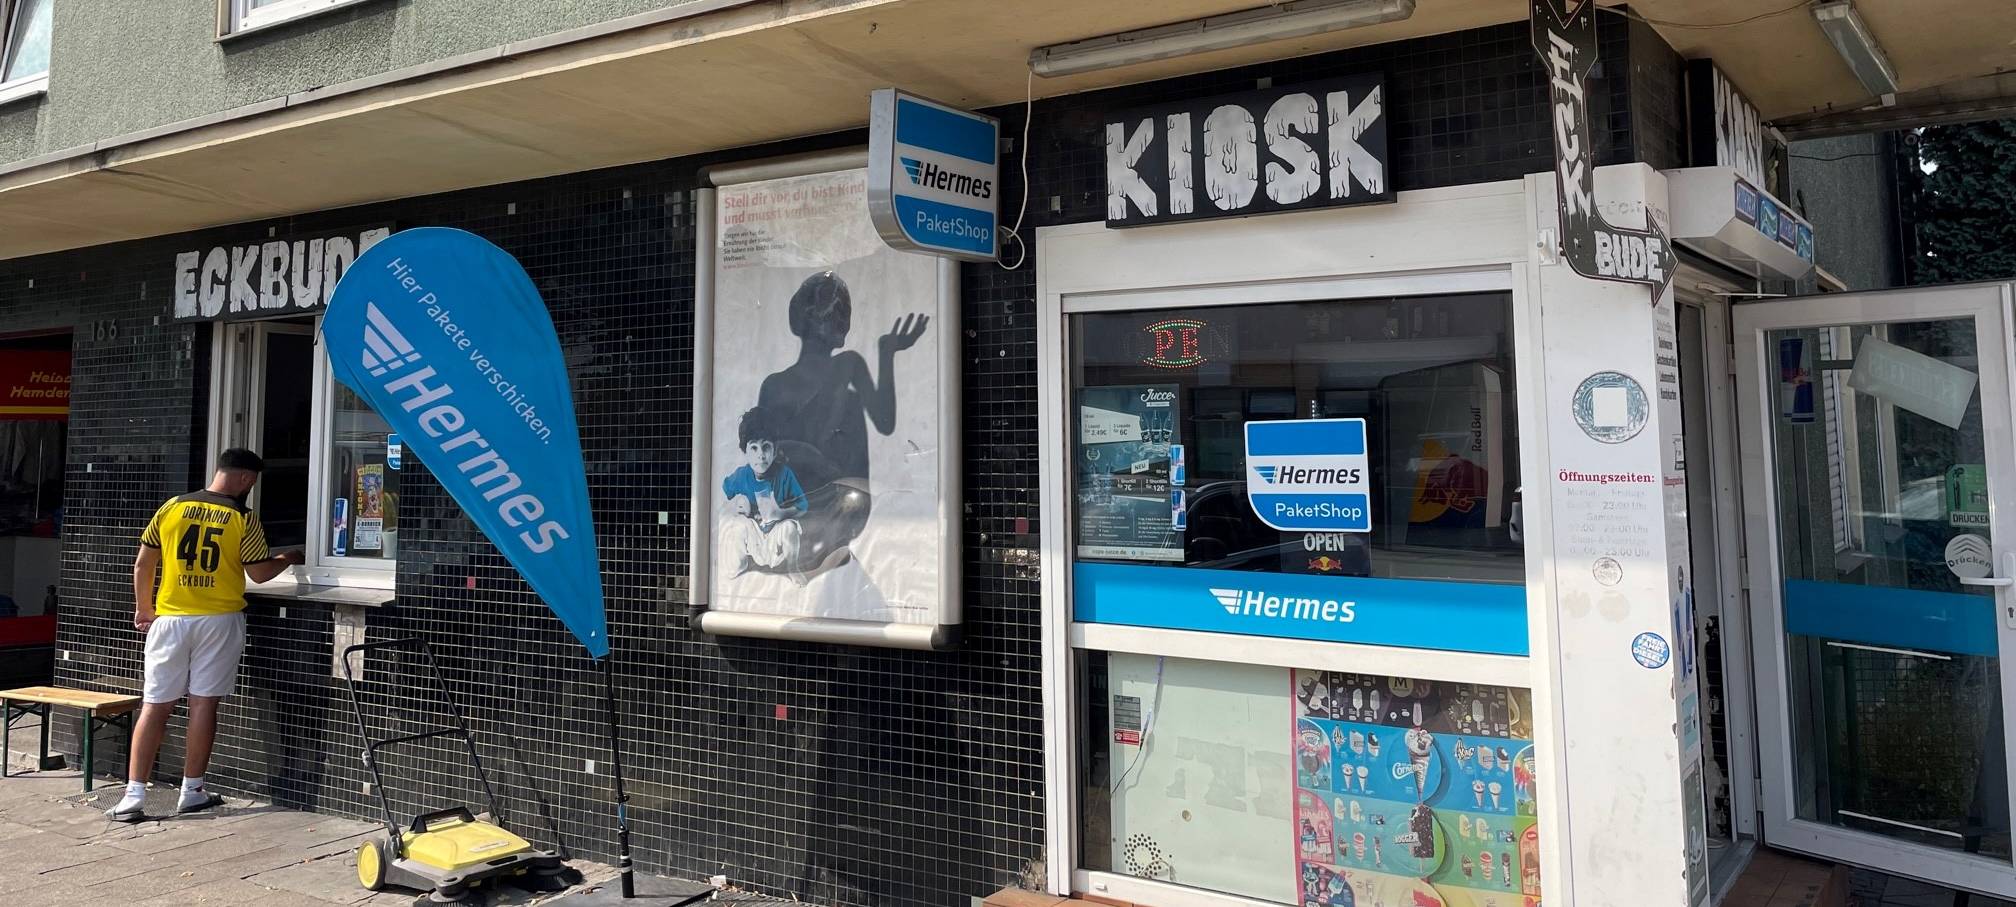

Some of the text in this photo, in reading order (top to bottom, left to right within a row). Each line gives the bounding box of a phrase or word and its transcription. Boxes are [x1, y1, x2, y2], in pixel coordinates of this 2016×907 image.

[1547, 28, 1592, 224] ECK
[1105, 84, 1385, 220] KIOSK
[922, 161, 992, 200] Hermes
[724, 192, 749, 209] Stell
[751, 191, 767, 205] dir
[811, 185, 834, 199] bist
[724, 210, 745, 225] und
[916, 210, 989, 242] PaketShop
[1595, 231, 1664, 284] BUDE
[386, 257, 423, 294] Hier
[418, 291, 473, 351] Pakete
[467, 345, 553, 446] verschicken.
[384, 364, 570, 555] Hermes
[1134, 462, 1147, 471] NEU
[1279, 464, 1361, 484] Hermes
[1558, 468, 1656, 485] Öffnungszeiten:
[182, 505, 231, 525] DORTMUND
[1275, 502, 1362, 520] PaketShop
[176, 524, 224, 573] 45
[1303, 532, 1345, 552] OPEN
[1947, 554, 1992, 569] Drücken
[178, 574, 215, 588] ECKBUDE
[1243, 590, 1356, 624] Hermes
